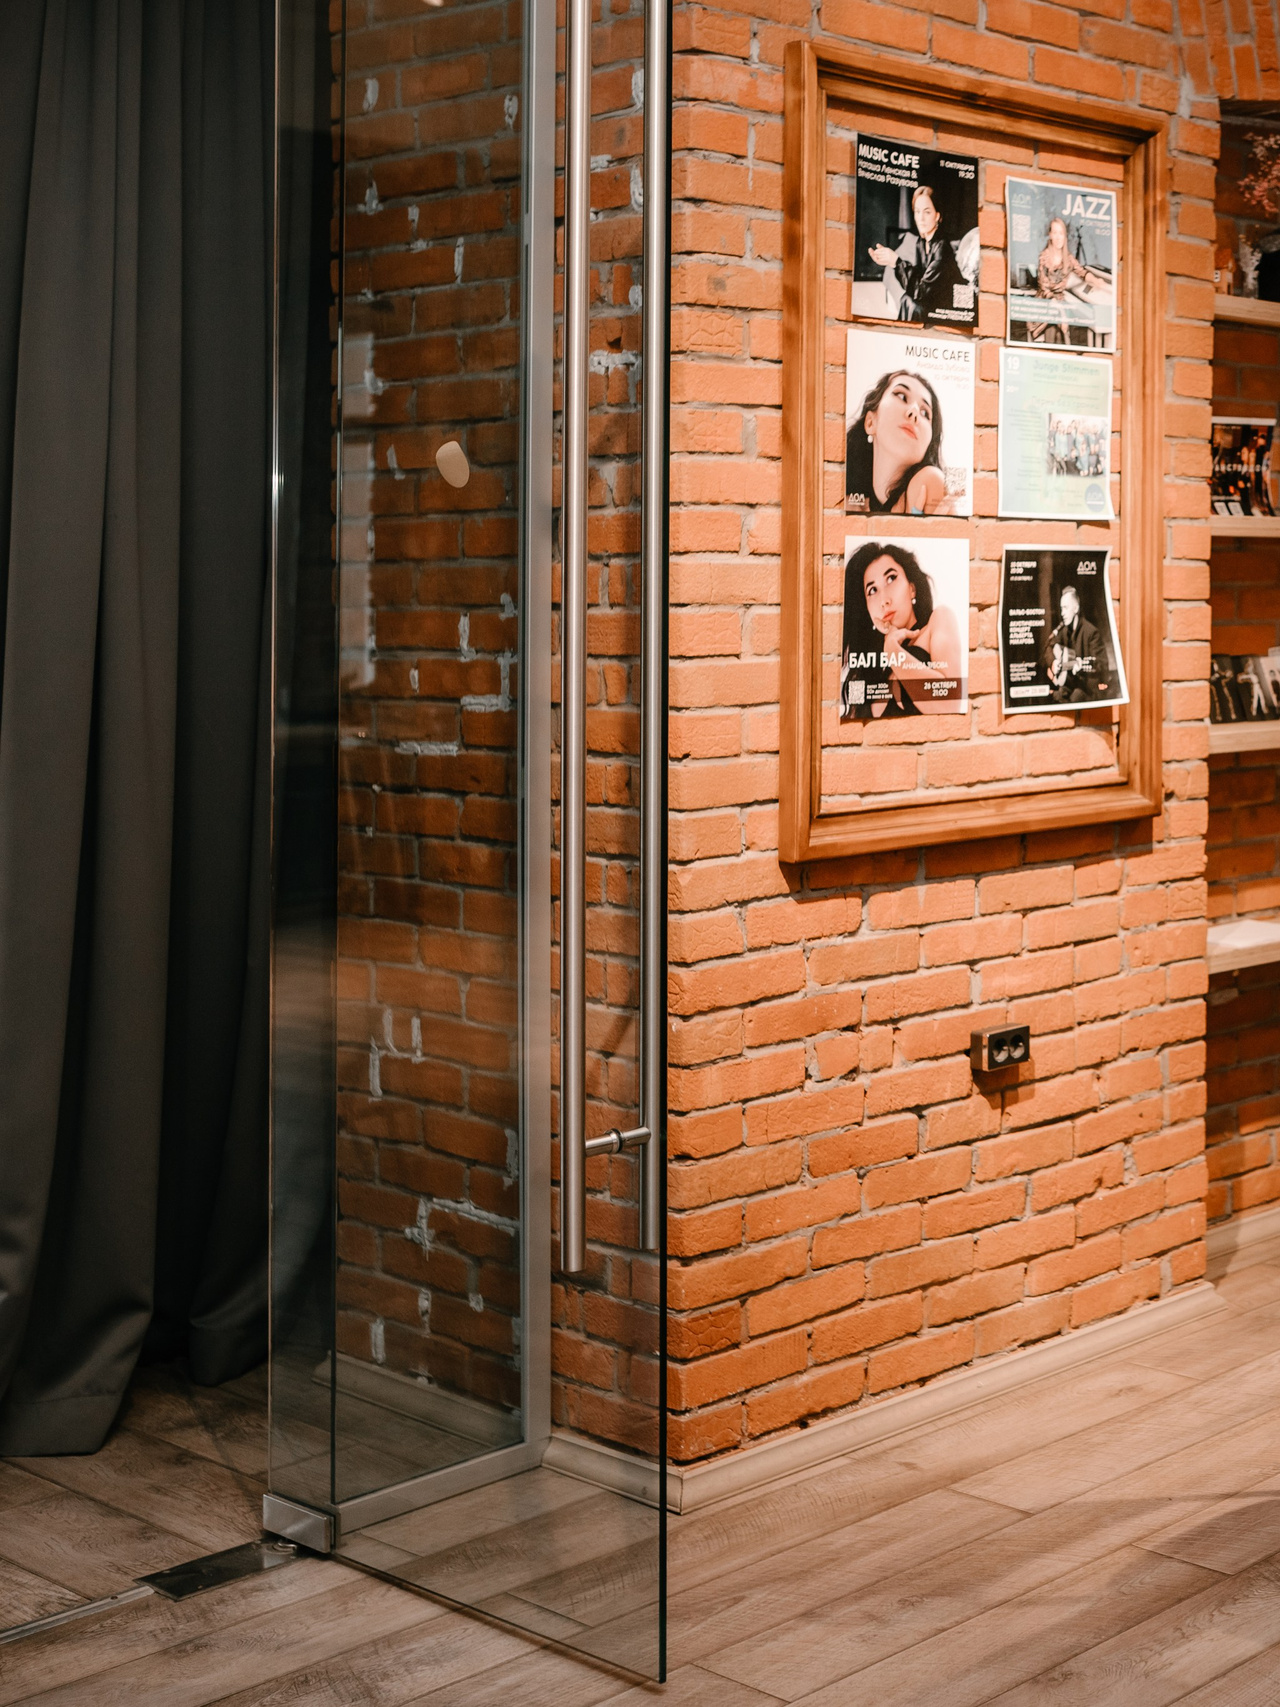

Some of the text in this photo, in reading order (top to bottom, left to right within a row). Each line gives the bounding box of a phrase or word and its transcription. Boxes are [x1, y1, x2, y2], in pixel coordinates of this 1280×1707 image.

[858, 143, 920, 169] MUSIC CAFE
[945, 160, 975, 171] ОКТЯБРЯ
[1061, 193, 1111, 220] JAZZ
[905, 345, 970, 362] MUSIC CAFE
[1006, 356, 1020, 370] 19
[848, 493, 865, 503] ДОМ
[1077, 561, 1097, 571] ДОМ
[849, 651, 877, 668] БАЛ
[880, 651, 907, 668] БАР
[932, 680, 958, 689] ОКТЯБРЯ
